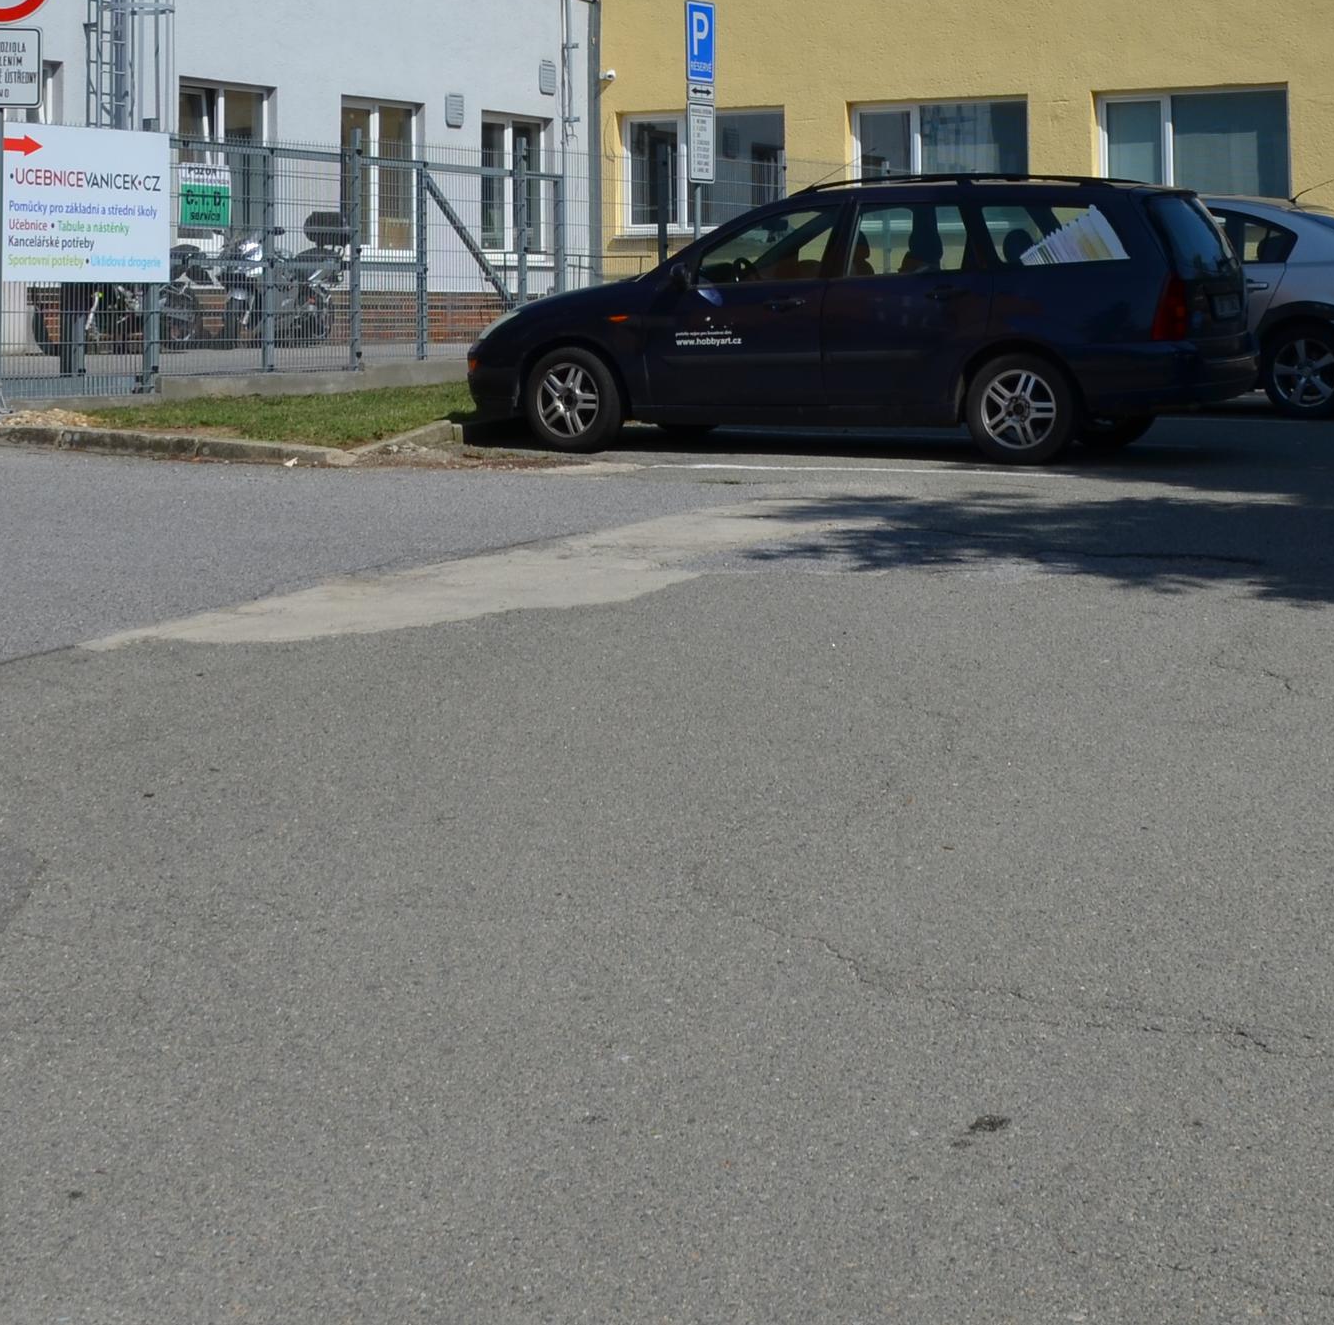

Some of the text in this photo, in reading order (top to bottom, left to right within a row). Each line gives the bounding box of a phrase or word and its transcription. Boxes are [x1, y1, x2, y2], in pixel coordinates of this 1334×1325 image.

[693, 11, 709, 56] P
[9, 200, 48, 215] Pomůcky
[49, 204, 64, 215] pro
[65, 202, 100, 215] základní
[108, 204, 136, 217] střední
[137, 205, 158, 220] školy
[9, 219, 48, 231] Učebnice
[58, 220, 85, 232] Tabule
[93, 222, 130, 236] nástěnky
[8, 235, 95, 251] Kancelářské potřeby
[8, 253, 50, 268] Sportovní
[51, 254, 84, 269] potřeby
[127, 256, 161, 269] drogerie
[676, 337, 742, 347] www.hobbyart.cz
